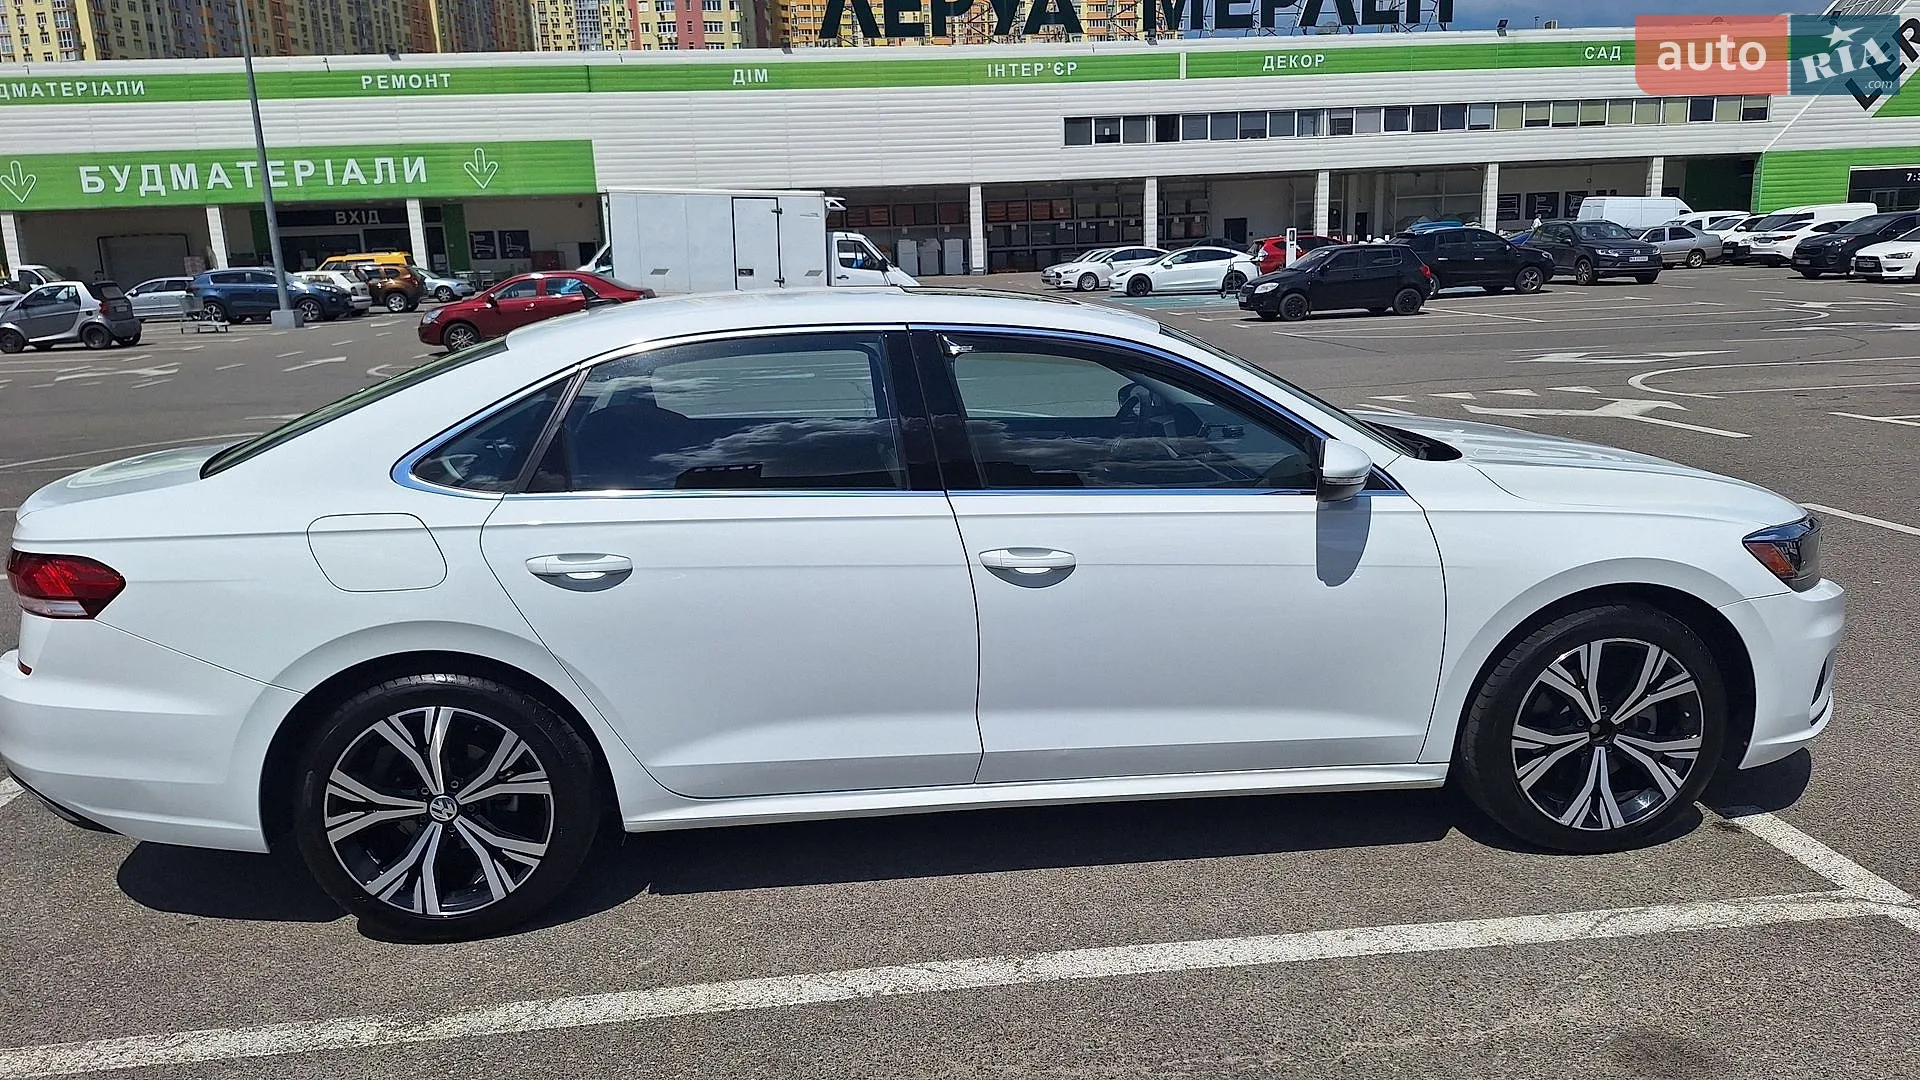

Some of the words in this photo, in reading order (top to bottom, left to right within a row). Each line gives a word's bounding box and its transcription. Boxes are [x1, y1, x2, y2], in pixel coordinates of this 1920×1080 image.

[1584, 46, 1621, 61] САД
[1262, 54, 1325, 72] ДЕКОР
[361, 73, 451, 90] РЕМОНТ
[732, 68, 769, 86] ДІМ
[79, 155, 428, 198] БУДМАТЕРІАЛИ
[335, 210, 381, 225] ВХІД
